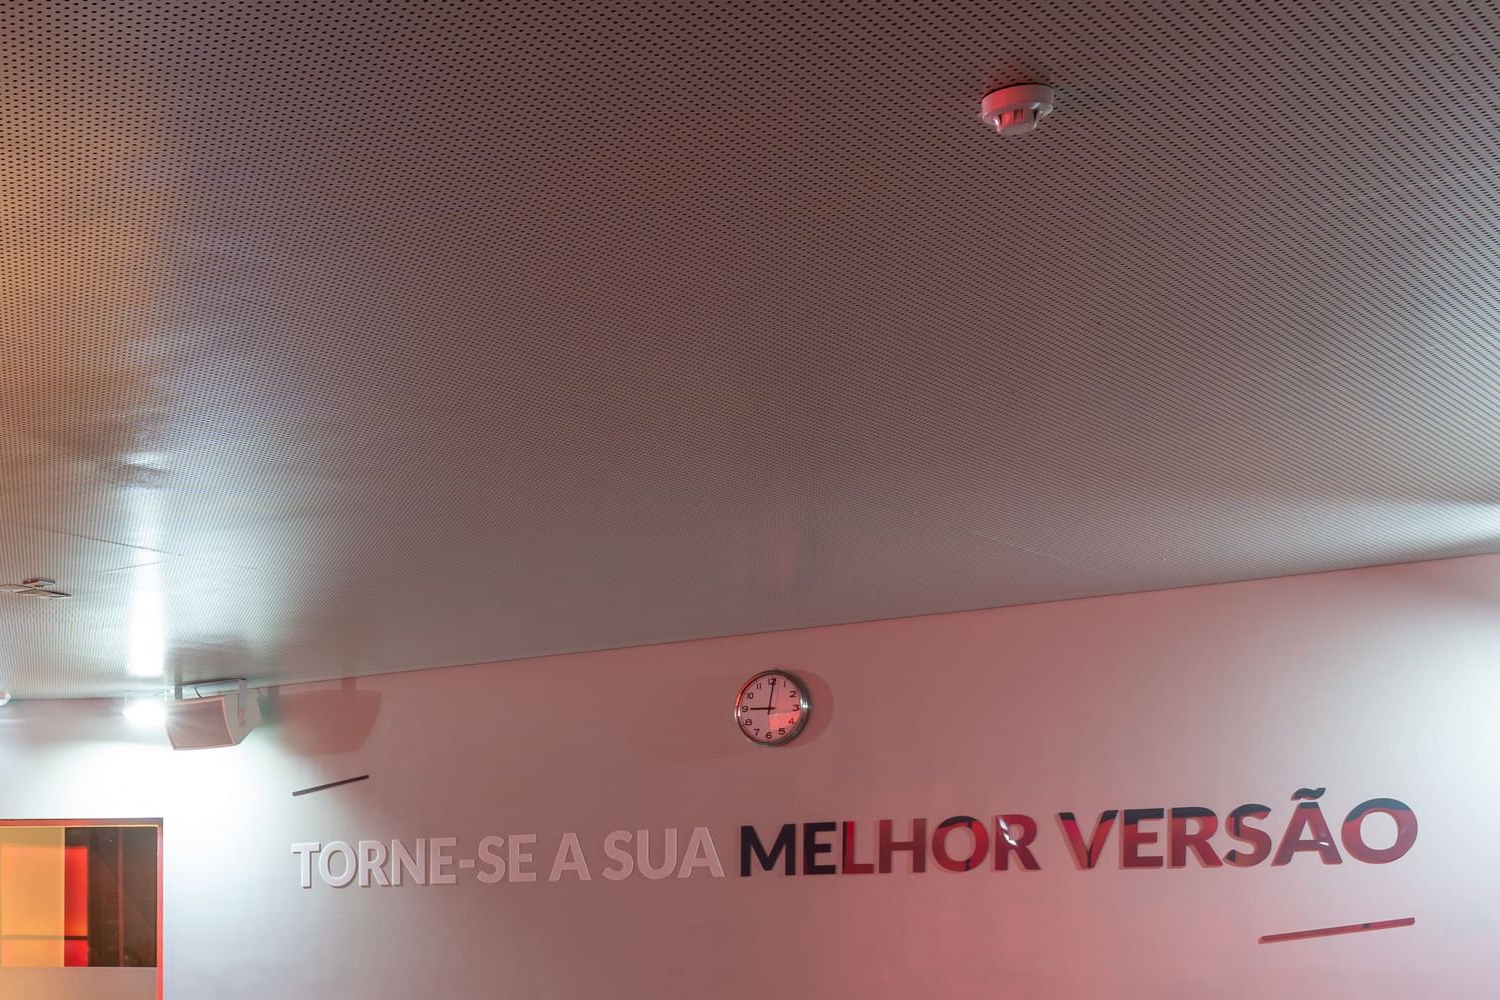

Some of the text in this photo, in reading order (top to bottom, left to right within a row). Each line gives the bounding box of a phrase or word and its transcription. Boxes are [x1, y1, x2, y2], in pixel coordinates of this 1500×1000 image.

[792, 704, 800, 712] 3
[745, 718, 753, 726] 8
[753, 728, 760, 736] 7
[291, 787, 1419, 889] TORNE-SE A SUA MELHOR VERSÃO
